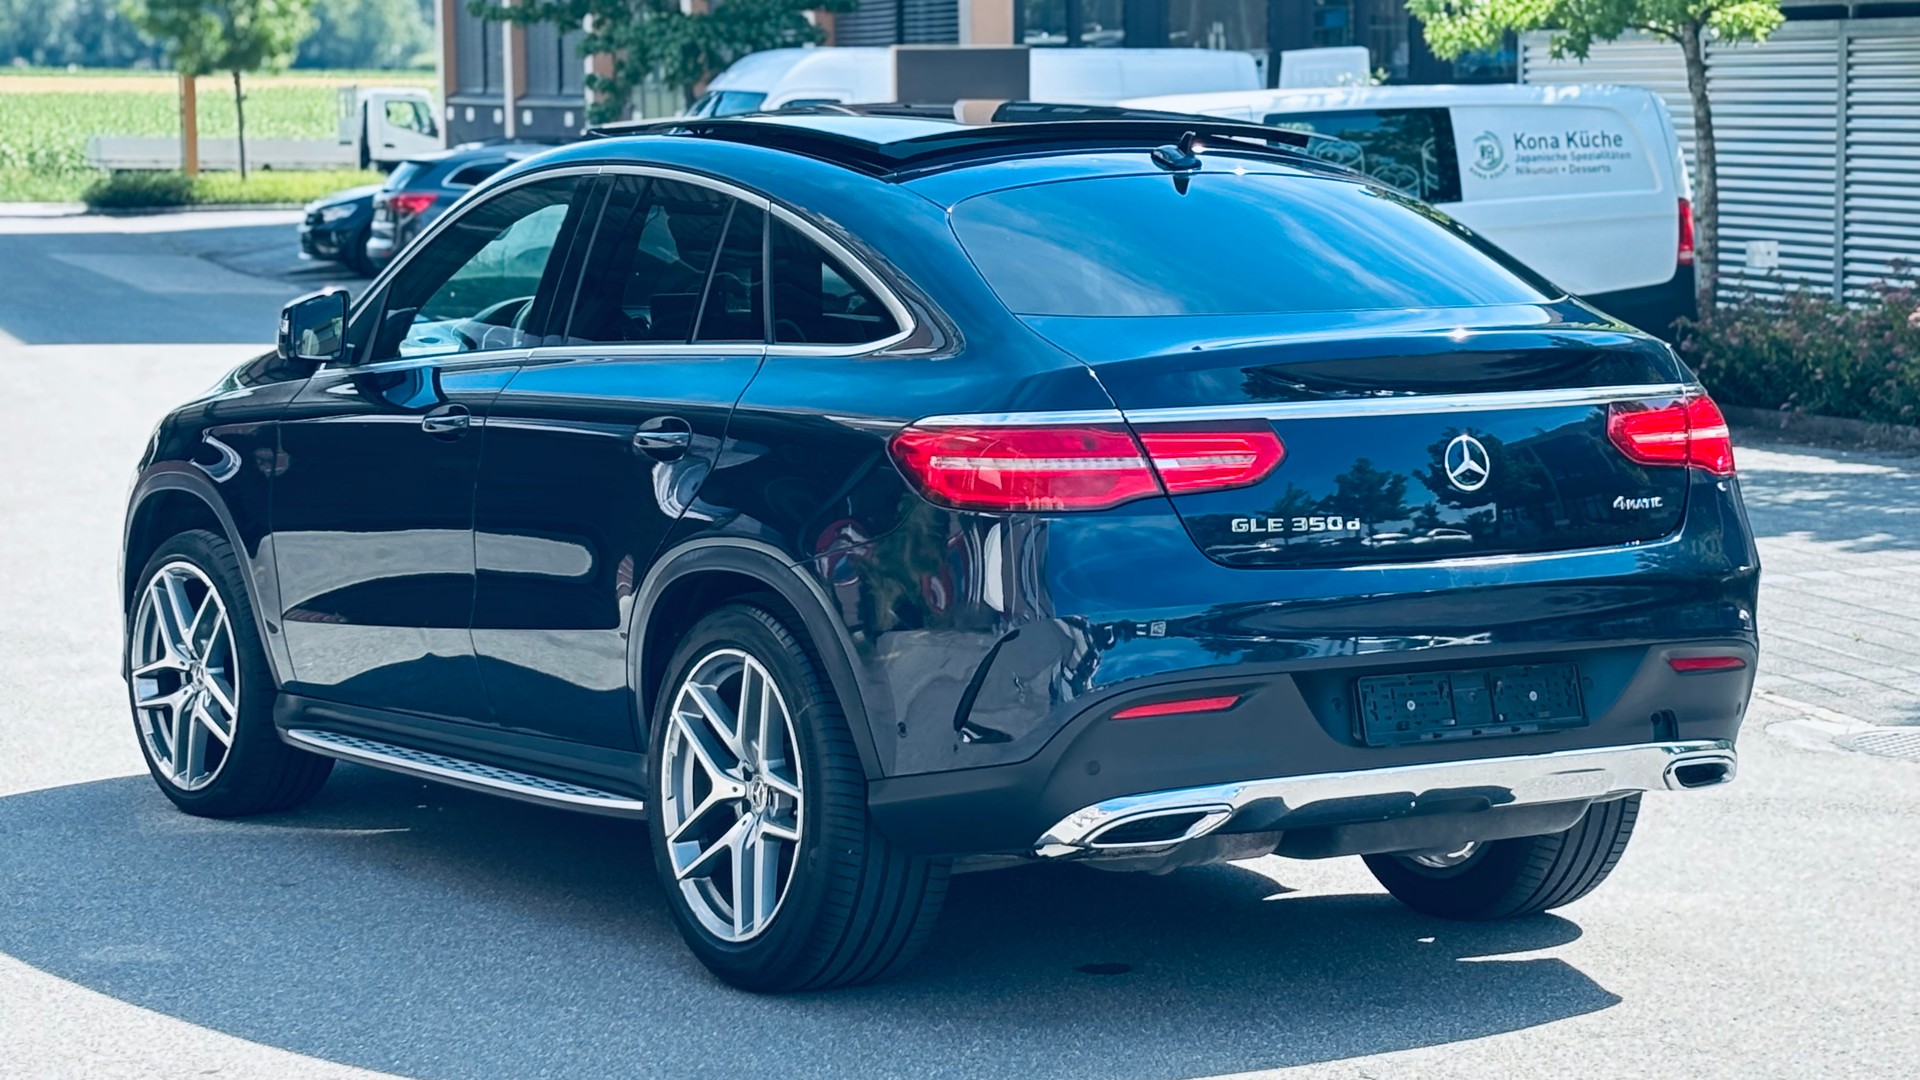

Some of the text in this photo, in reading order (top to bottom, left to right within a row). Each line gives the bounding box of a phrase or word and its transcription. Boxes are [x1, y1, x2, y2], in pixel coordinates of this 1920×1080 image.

[1513, 130, 1623, 150] Kona Küche
[1515, 151, 1631, 163] Japanische Spezialitäten
[1569, 164, 1611, 174] Desserts
[1231, 518, 1284, 532] GLE
